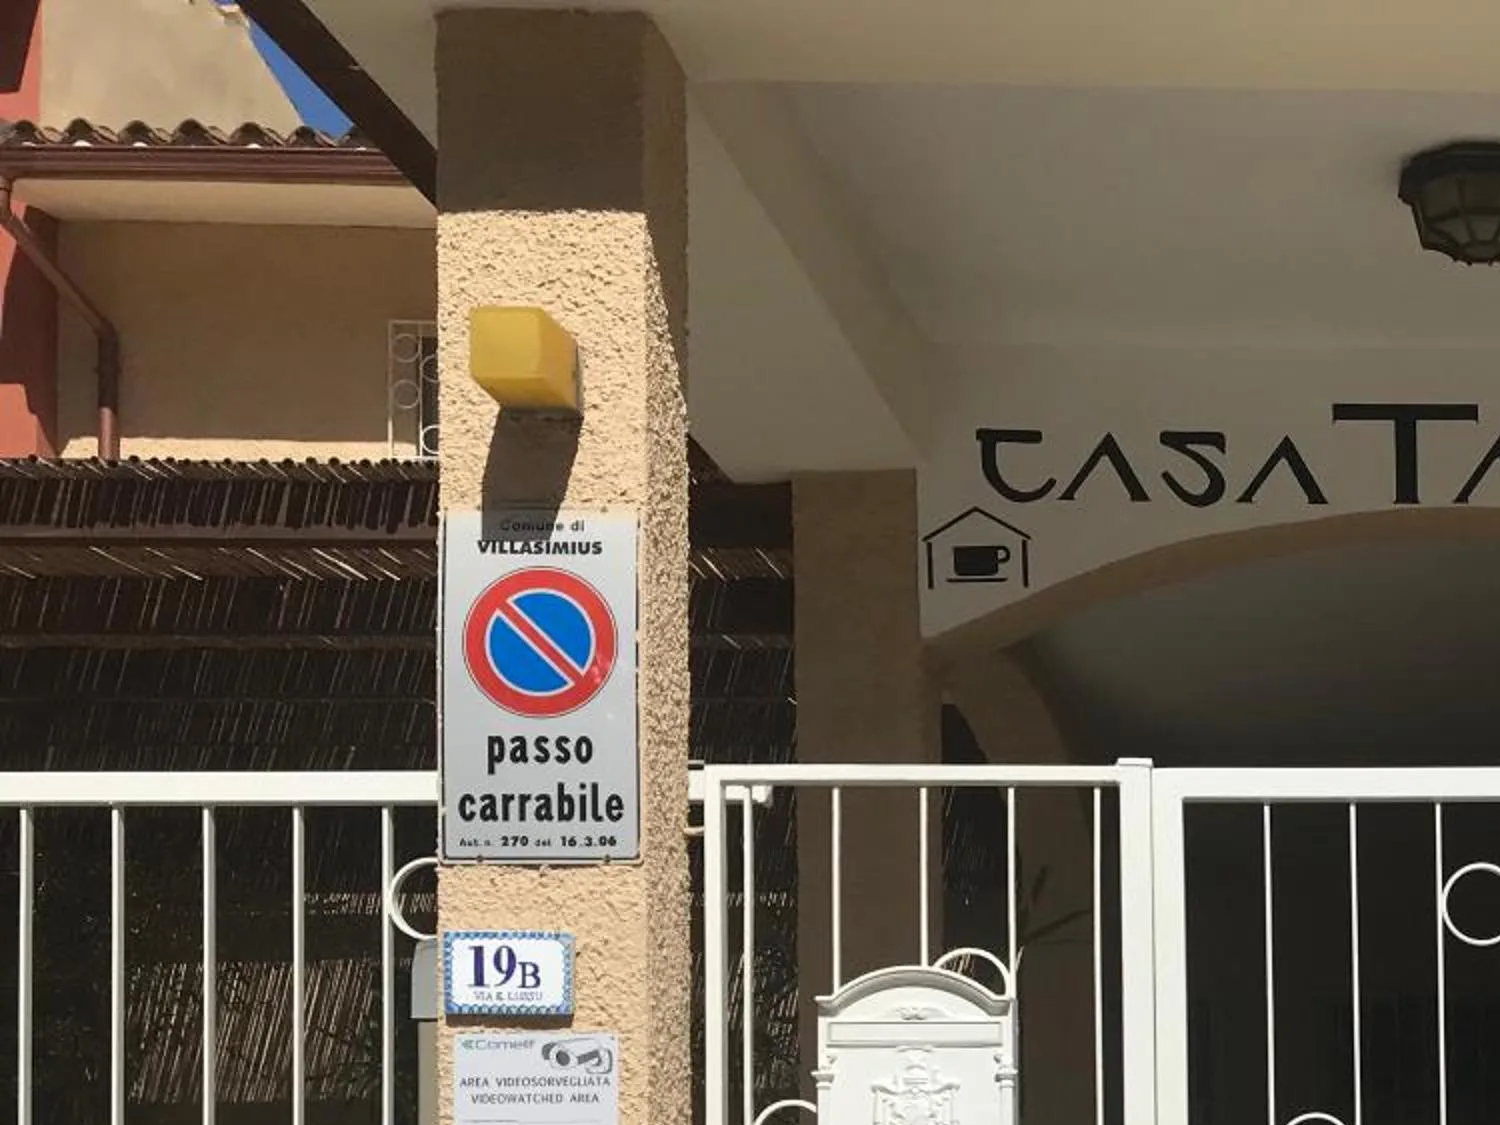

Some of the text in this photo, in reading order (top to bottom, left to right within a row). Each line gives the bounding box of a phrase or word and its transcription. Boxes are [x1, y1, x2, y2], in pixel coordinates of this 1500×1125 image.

[976, 428, 1329, 507] CASA
[501, 519, 585, 532] Comune di
[477, 540, 603, 555] VILLASIMIUS
[487, 735, 593, 775] passo
[458, 782, 625, 823] carrabile
[501, 835, 529, 848] 270
[560, 834, 617, 848] 16.3.06
[460, 1075, 611, 1088] AREA VIDEOSORVEGLIATA
[471, 1092, 600, 1105] VIDEOWATCHED AREA
